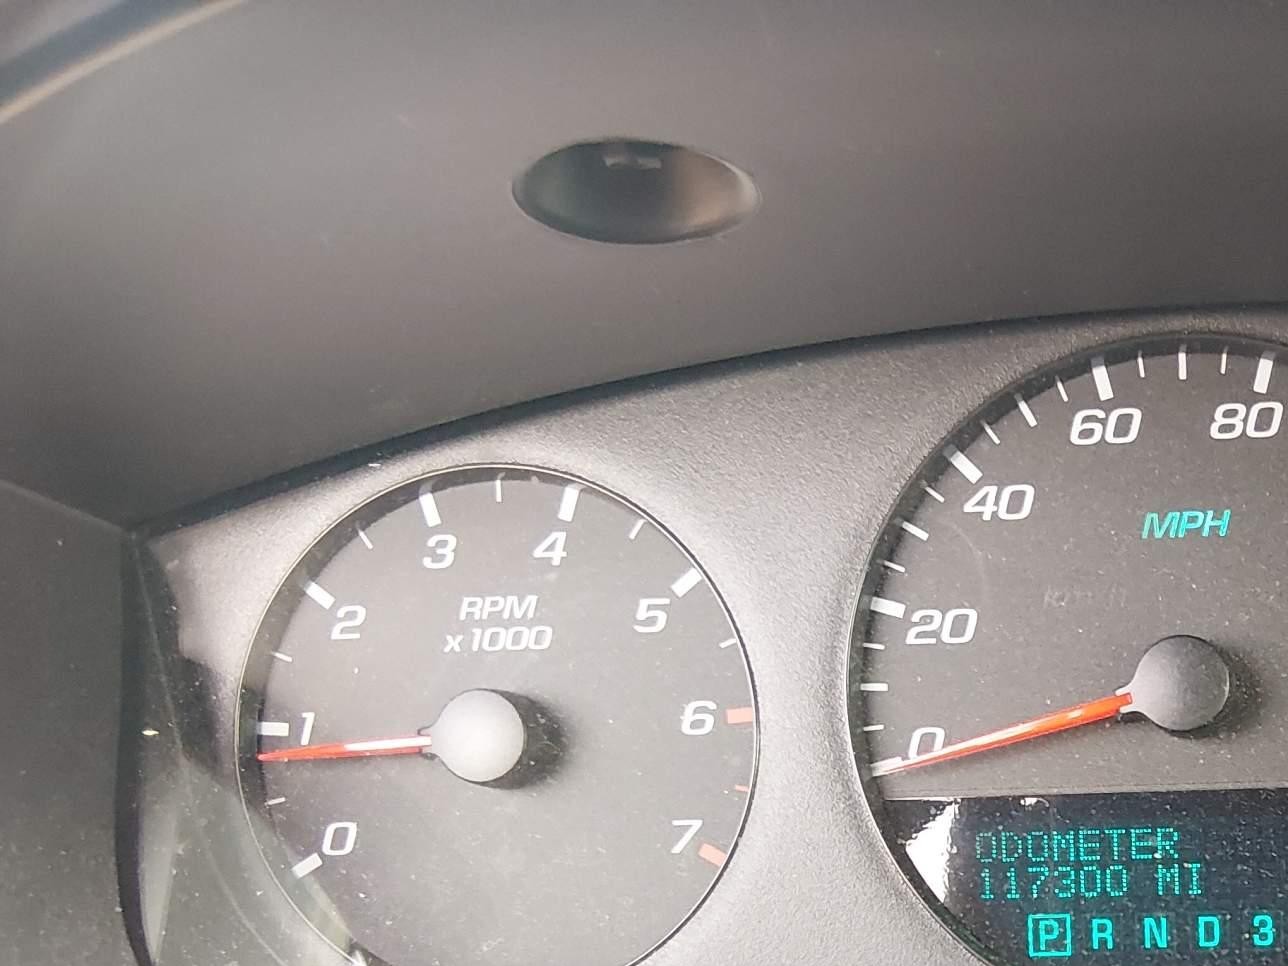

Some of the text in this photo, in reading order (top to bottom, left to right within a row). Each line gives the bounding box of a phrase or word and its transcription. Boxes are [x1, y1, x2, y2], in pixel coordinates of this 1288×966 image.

[1069, 407, 1142, 446] 60
[1209, 401, 1284, 440] 80
[962, 483, 1035, 521] 40
[1140, 509, 1232, 540] MPH
[422, 533, 458, 570] 3
[531, 531, 568, 567] 4
[330, 604, 368, 640] 2
[458, 594, 540, 621] RPM
[632, 597, 672, 634] 5
[443, 624, 554, 653] x 1000
[904, 607, 979, 645] 20
[300, 711, 316, 746] 1
[678, 700, 718, 736] 6
[907, 726, 946, 763] 0
[320, 821, 358, 857] 0
[670, 819, 703, 855] 7
[975, 827, 1179, 863] ODOMETER
[980, 863, 1202, 899] 117300 MI
[1038, 918, 1060, 951] P
[1091, 918, 1114, 950] R
[1143, 916, 1169, 949] N
[1198, 915, 1221, 948] D
[1252, 914, 1275, 947] 3
